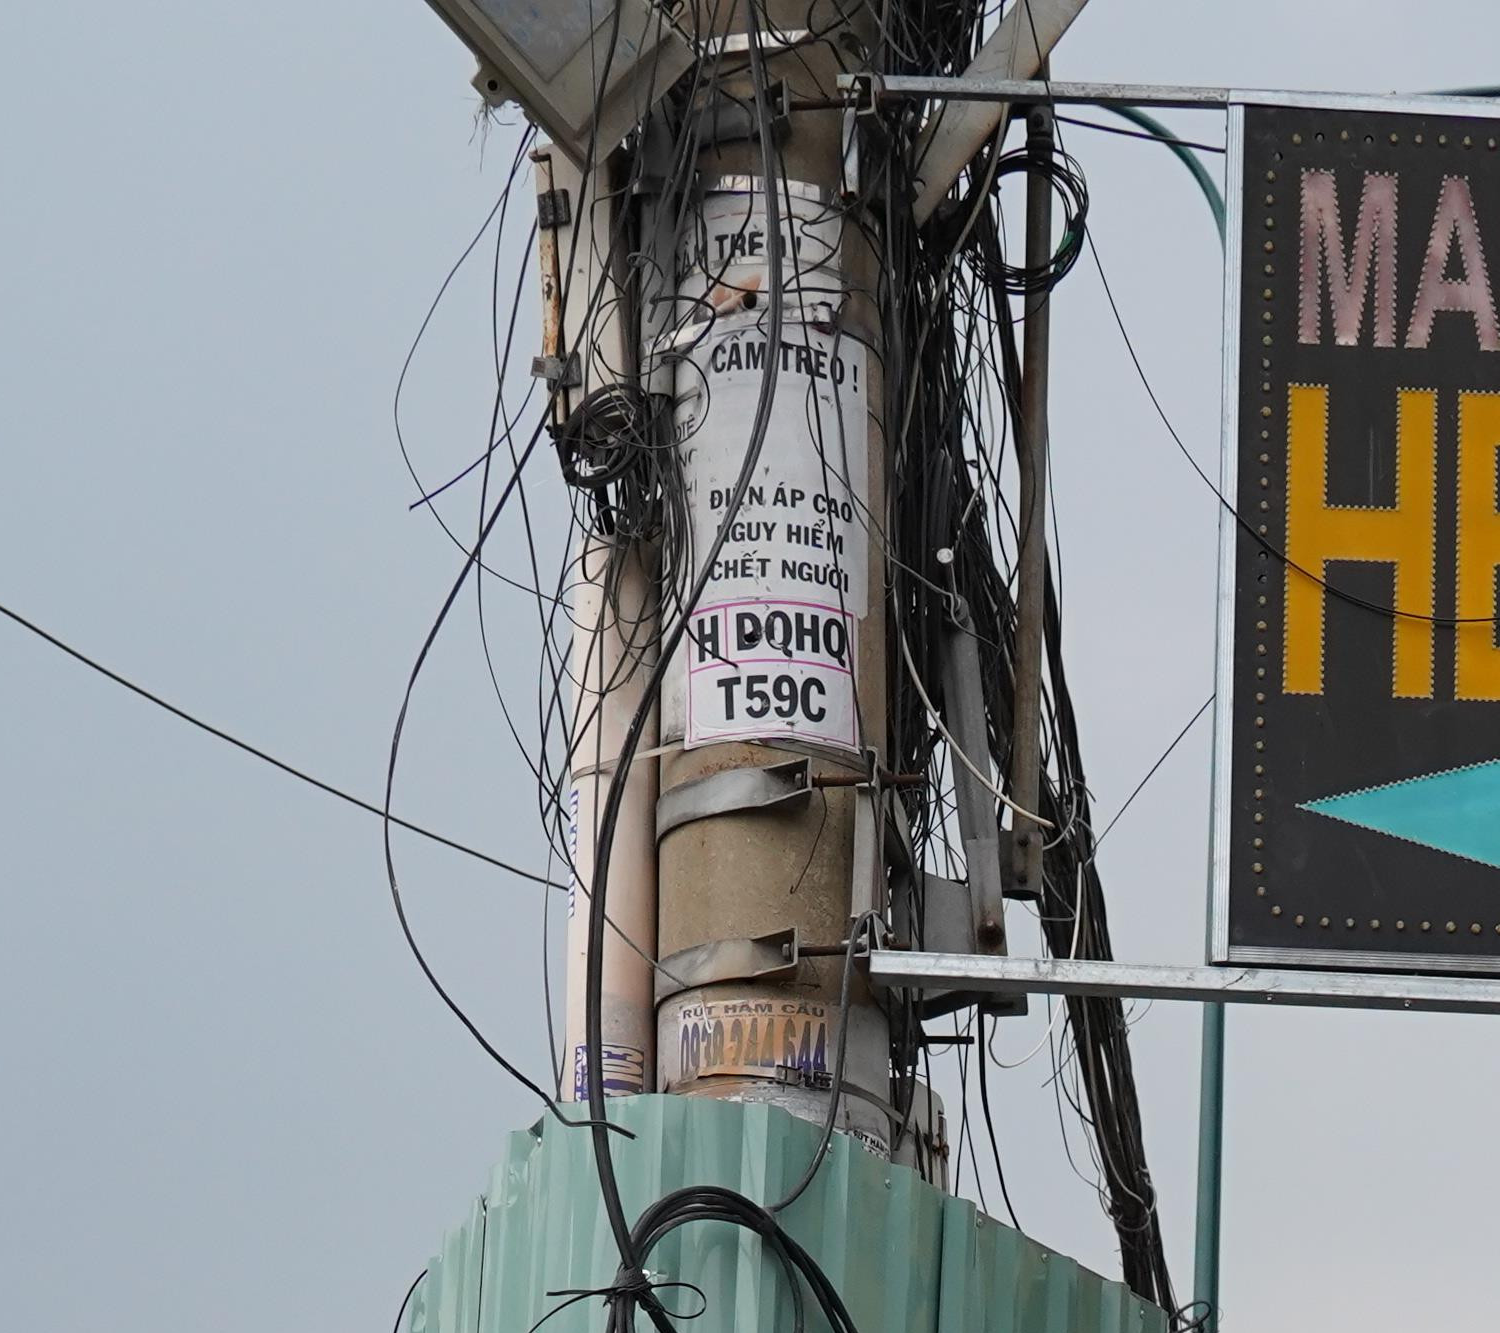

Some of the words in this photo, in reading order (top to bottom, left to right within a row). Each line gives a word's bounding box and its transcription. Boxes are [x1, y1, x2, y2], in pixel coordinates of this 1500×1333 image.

[711, 330, 767, 373] CẤM
[782, 342, 845, 385] TRÈO
[772, 481, 805, 508] ÁP
[812, 494, 853, 523] CAO
[786, 518, 843, 555] HIỂM
[709, 550, 771, 582] CHẾT
[781, 559, 849, 594] NGƯỜI
[697, 615, 720, 663] H
[717, 674, 827, 723] T59C
